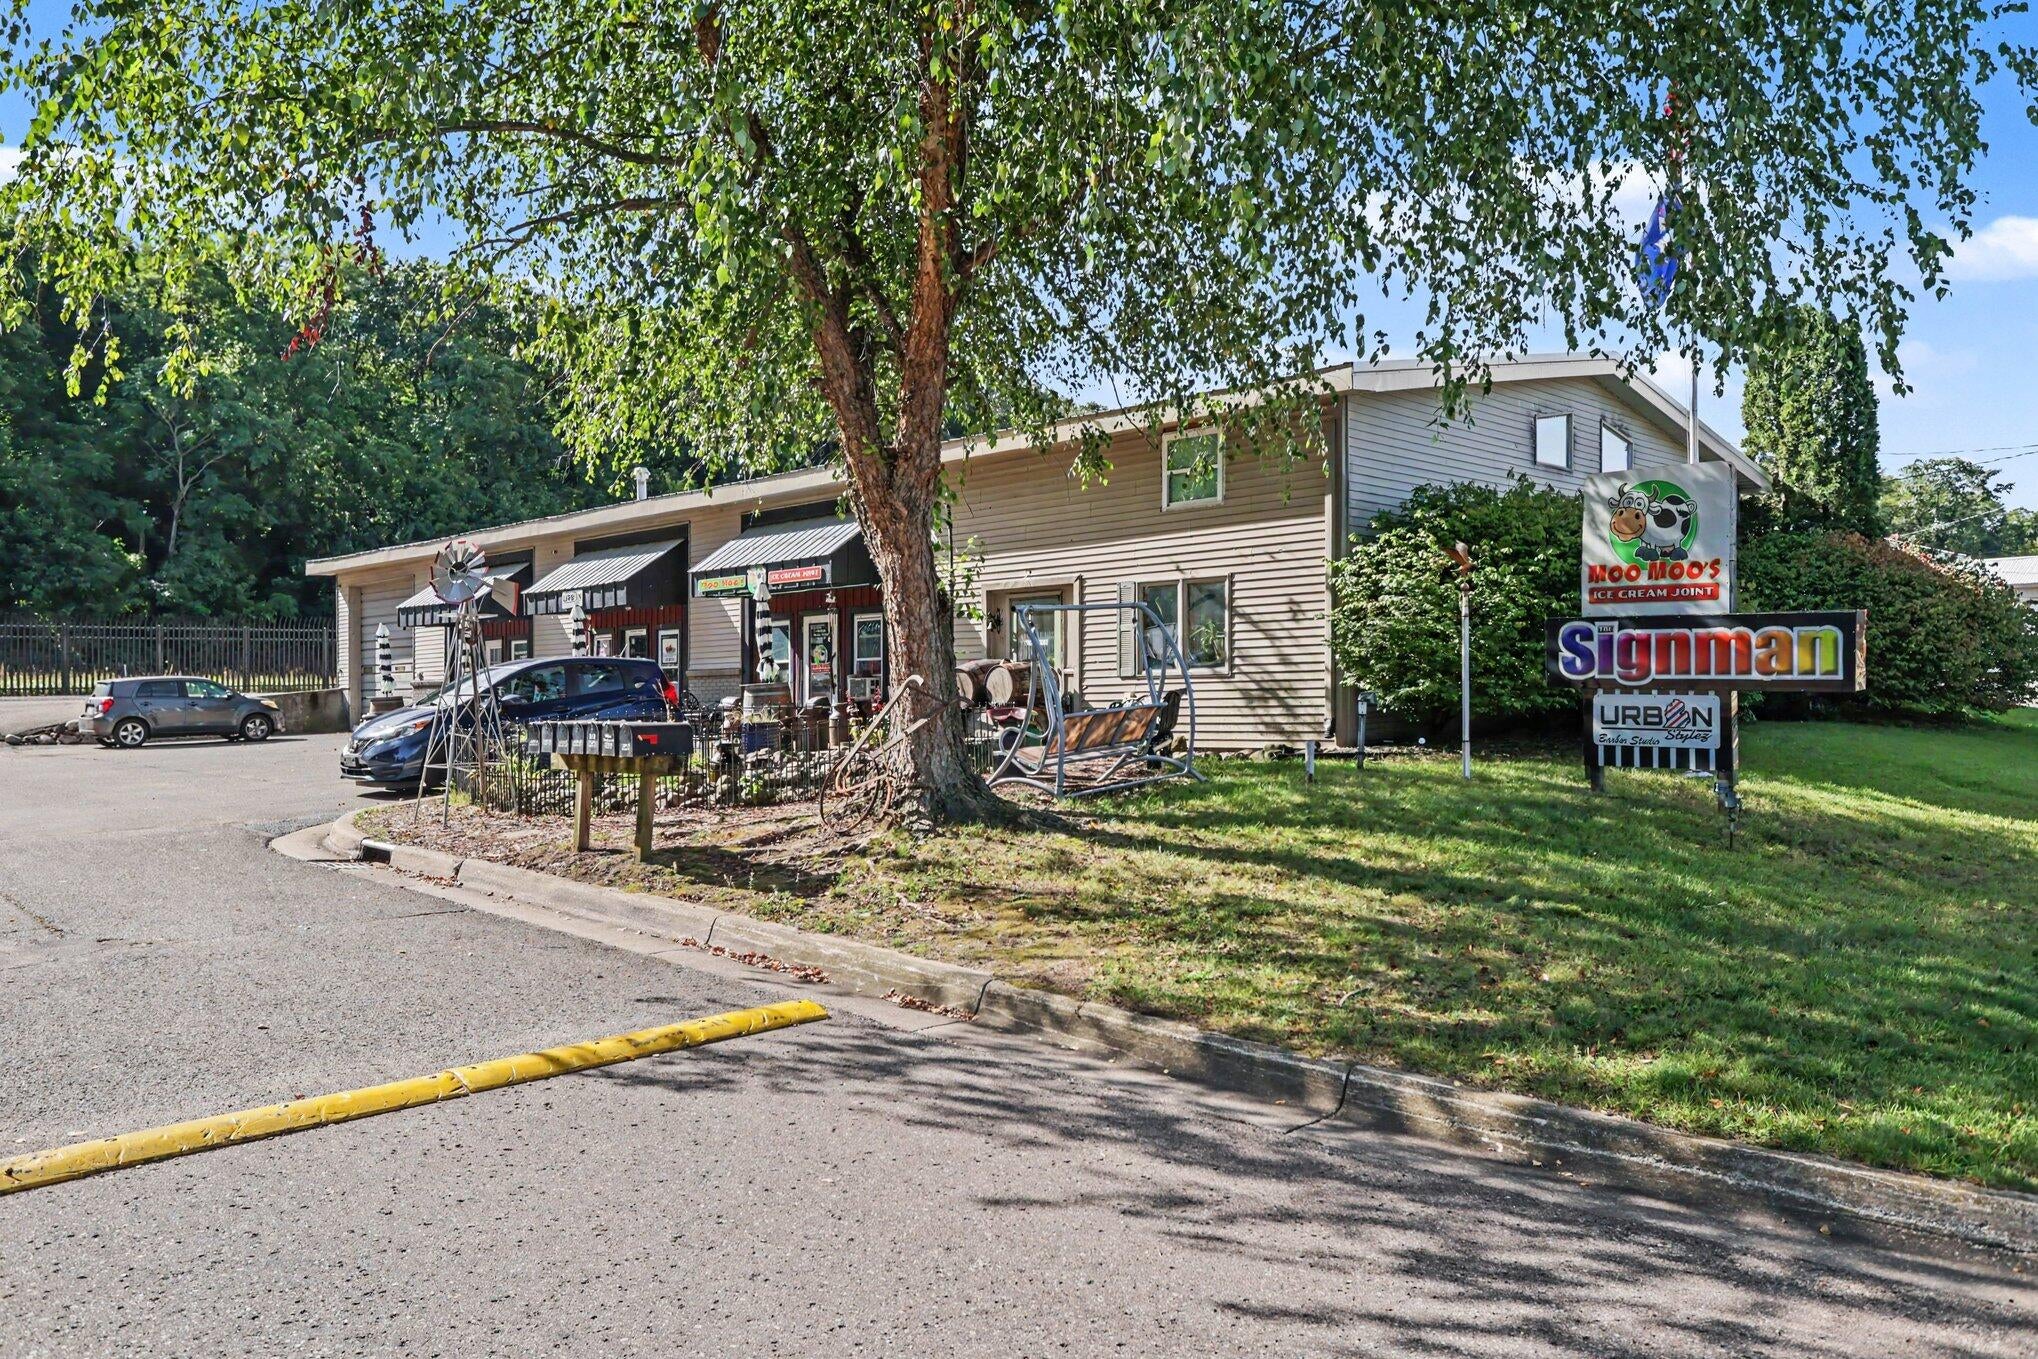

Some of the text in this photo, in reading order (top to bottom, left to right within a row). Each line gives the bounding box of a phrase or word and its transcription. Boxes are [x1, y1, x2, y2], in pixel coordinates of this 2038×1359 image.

[1588, 558, 1720, 583] MOO MOO'S
[1593, 586, 1714, 599] ICE CREAM JOINT
[1560, 622, 1842, 684] Signman
[1630, 736, 1660, 745] Studio
[1665, 729, 1713, 743] Stylez
